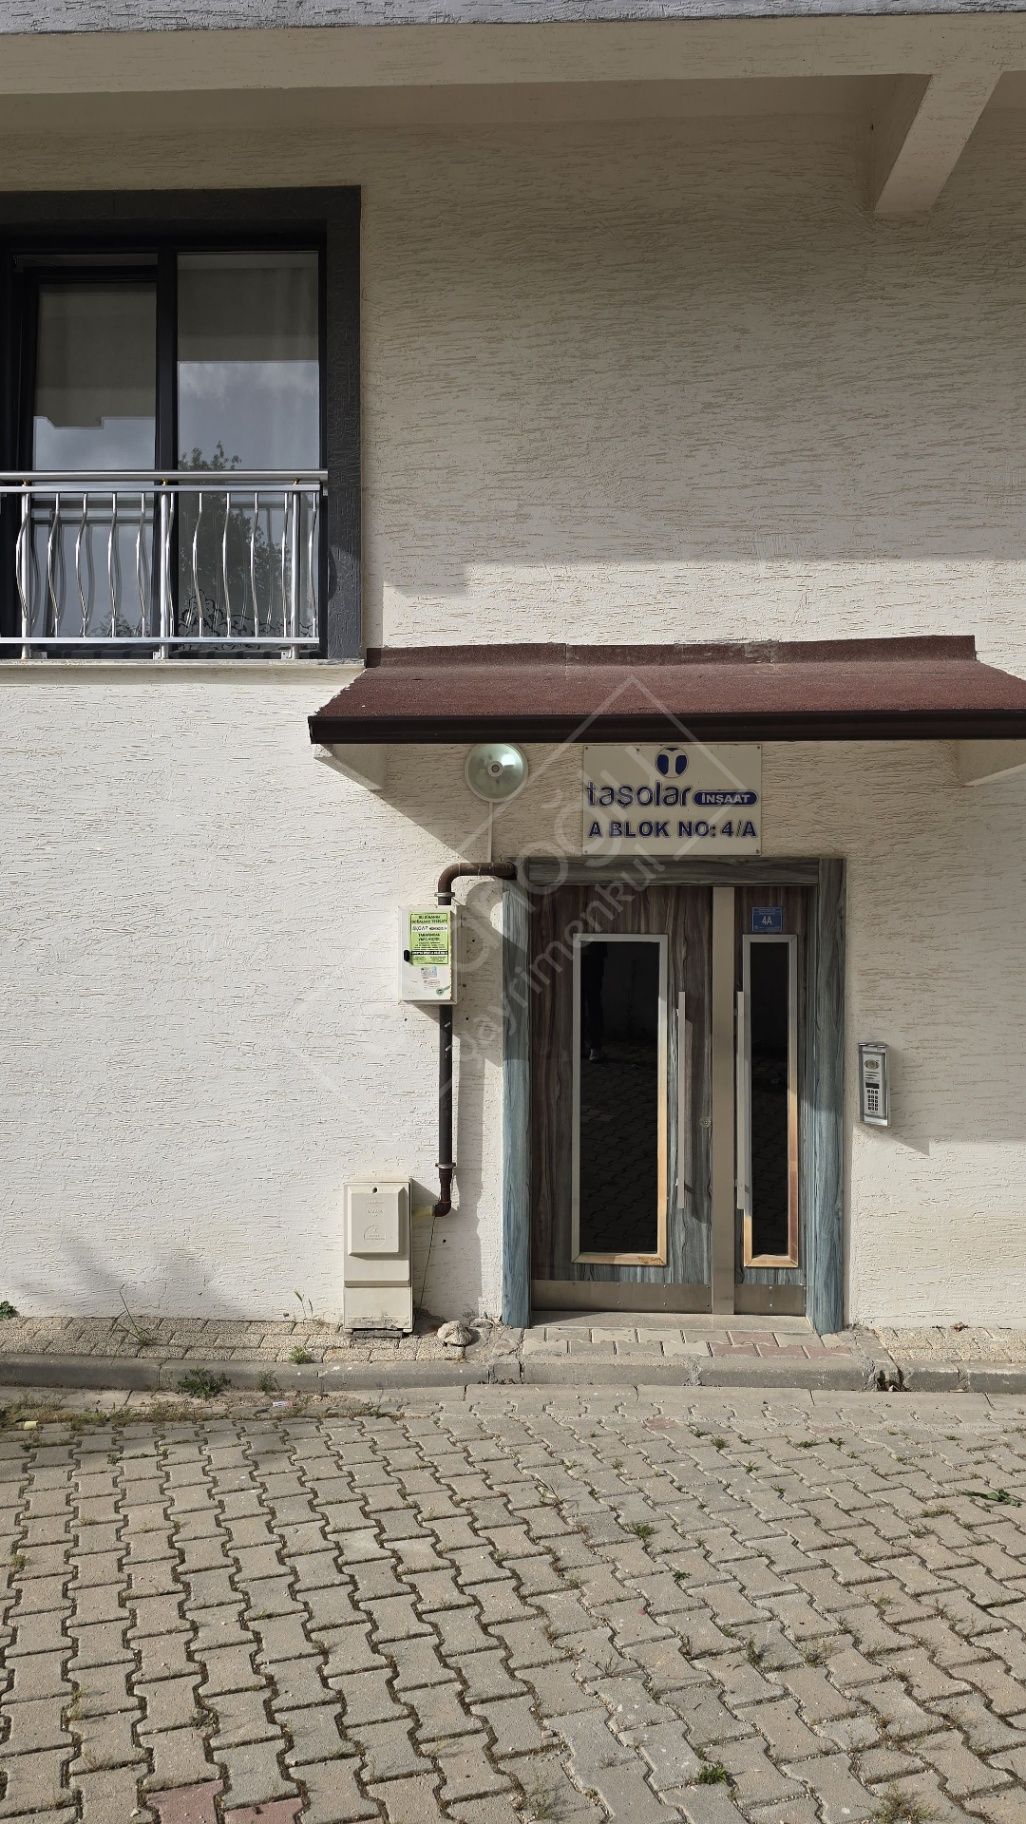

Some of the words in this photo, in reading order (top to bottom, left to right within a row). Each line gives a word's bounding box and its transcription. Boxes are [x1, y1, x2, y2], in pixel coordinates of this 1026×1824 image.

[701, 793, 751, 806] İNŞAAT
[588, 821, 602, 838] A
[609, 821, 669, 838] BLOK
[678, 821, 716, 838] NO:
[721, 821, 757, 838] 4/A
[762, 915, 773, 926] 4A
